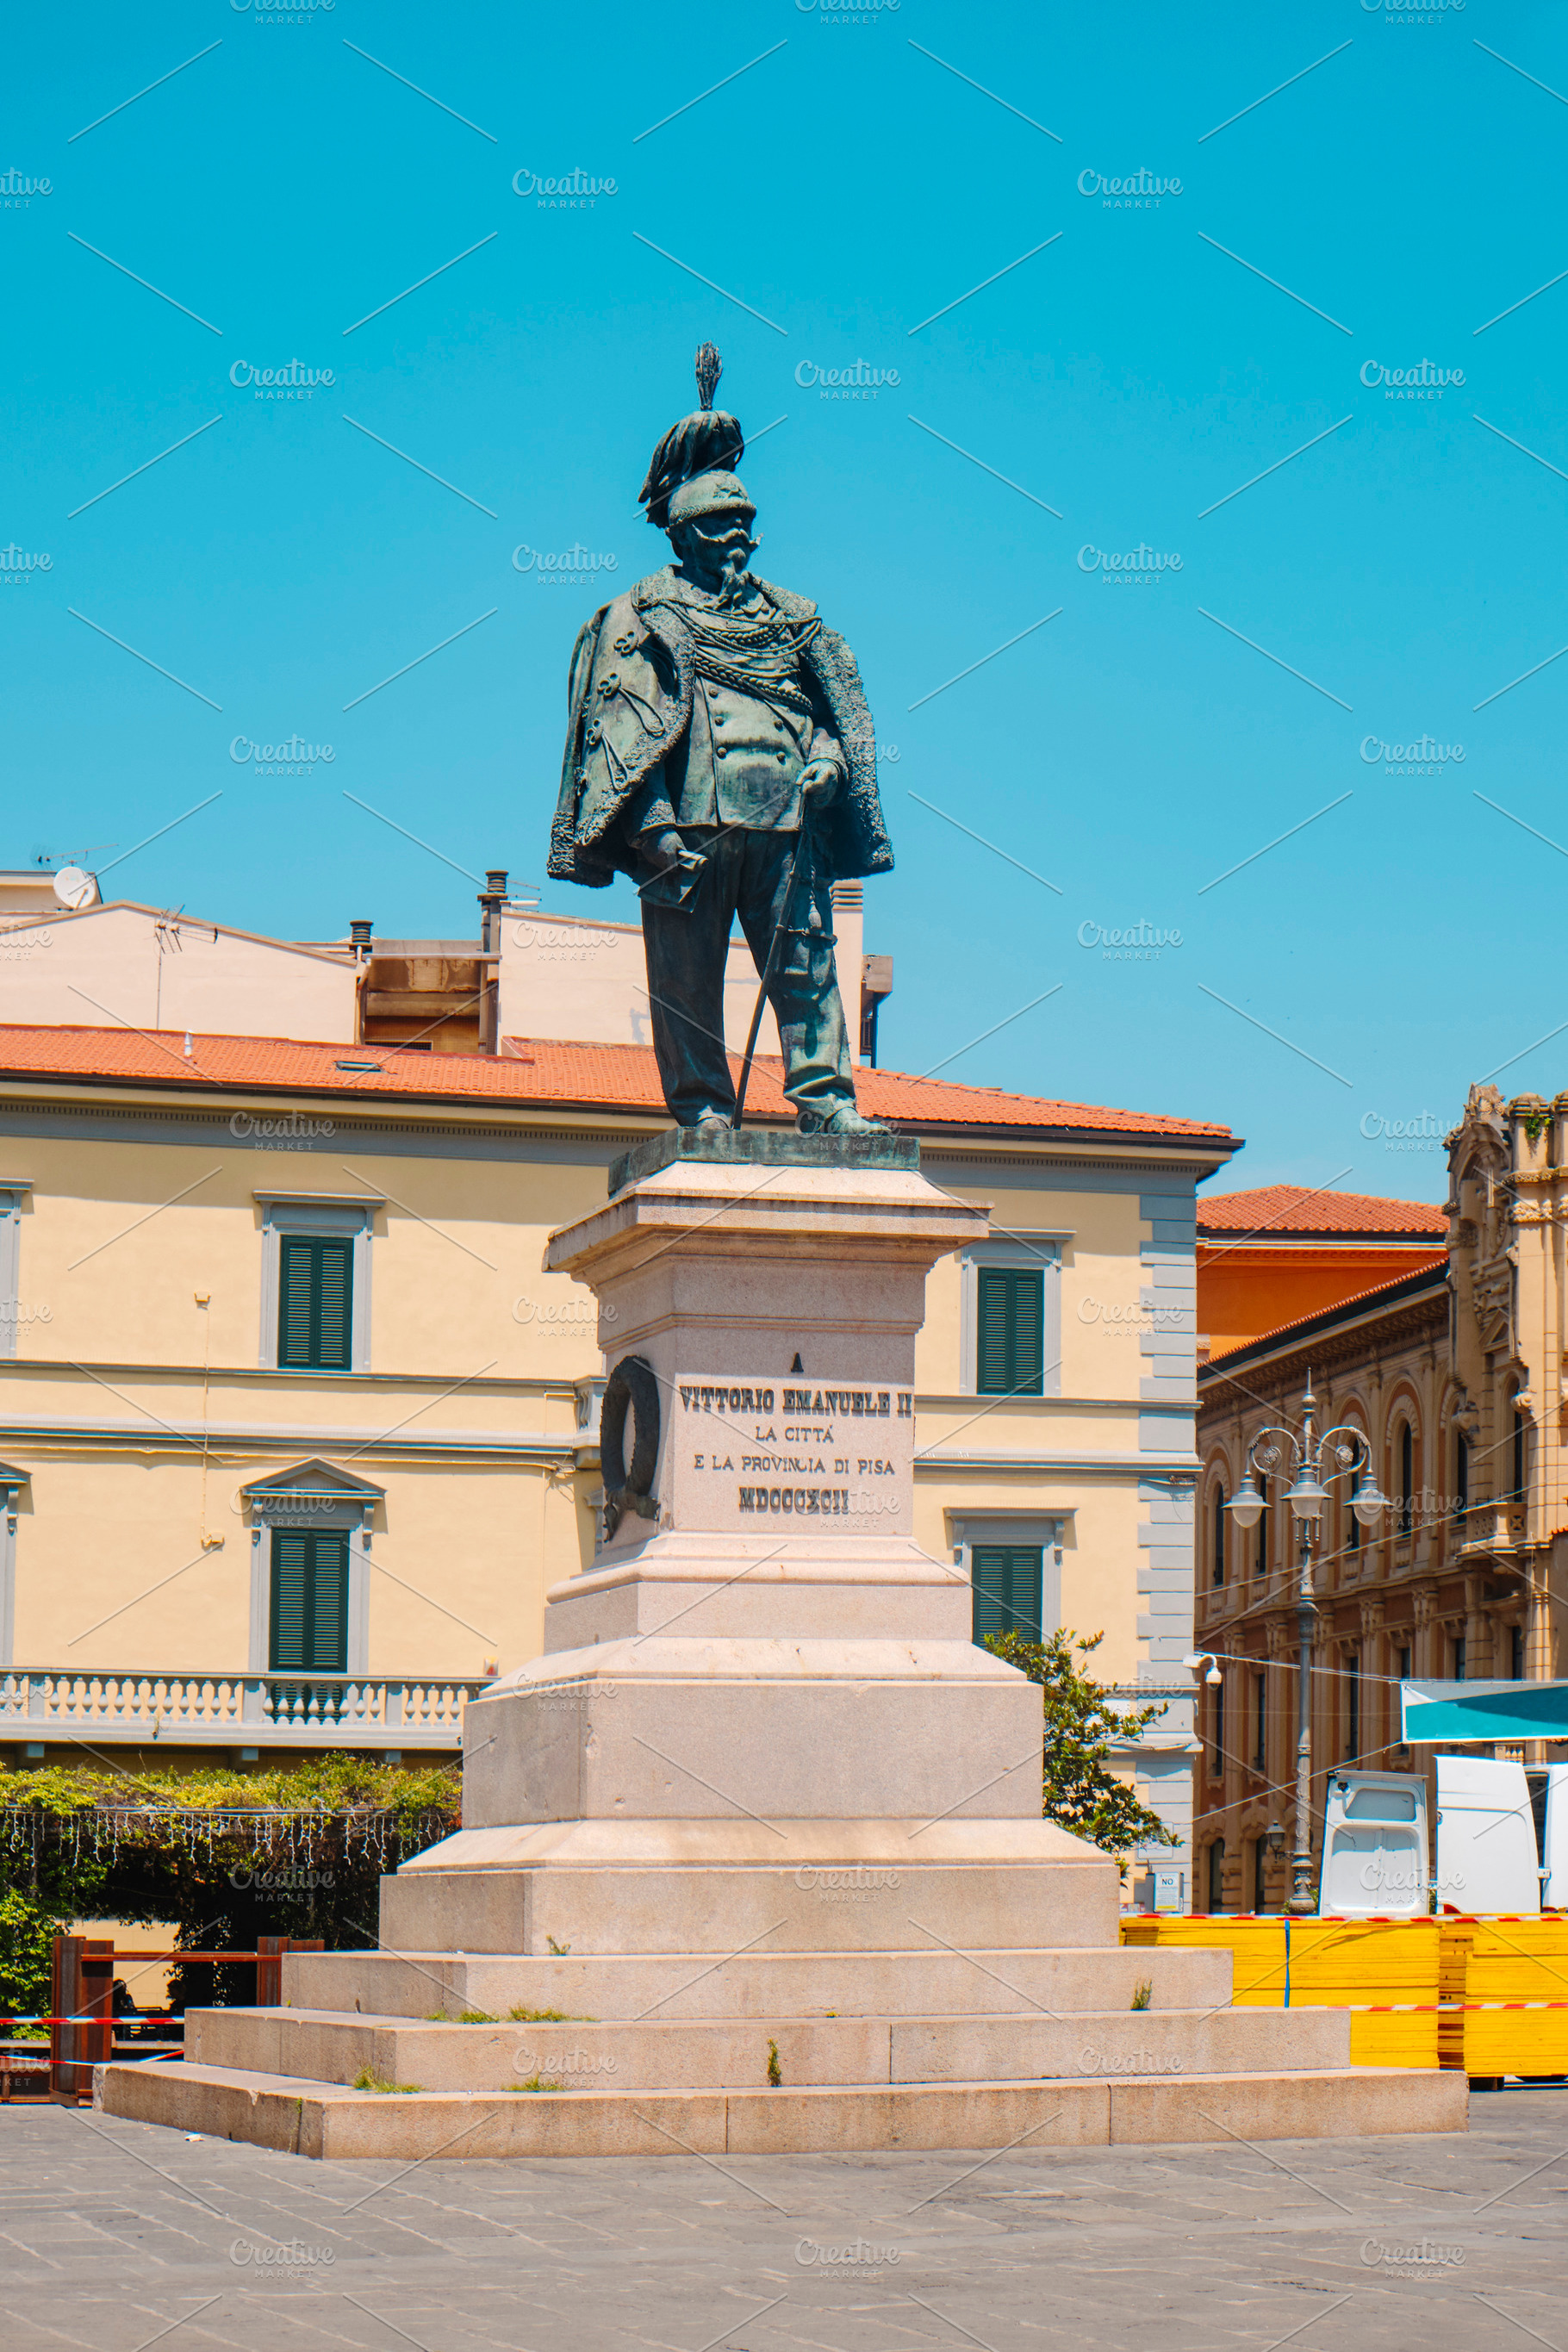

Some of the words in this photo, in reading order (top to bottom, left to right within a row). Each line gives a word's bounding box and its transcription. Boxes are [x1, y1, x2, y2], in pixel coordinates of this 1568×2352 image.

[791, 1353, 804, 1372] A
[679, 1385, 775, 1415] VITTORIO
[782, 1388, 890, 1417] EMANUELE
[897, 1392, 912, 1418] II
[756, 1426, 777, 1441] LA
[694, 1454, 705, 1470] E
[712, 1455, 734, 1471] LA
[834, 1459, 849, 1474] DI
[857, 1459, 895, 1475] PISA
[738, 1487, 849, 1515] MDCCCXCII
